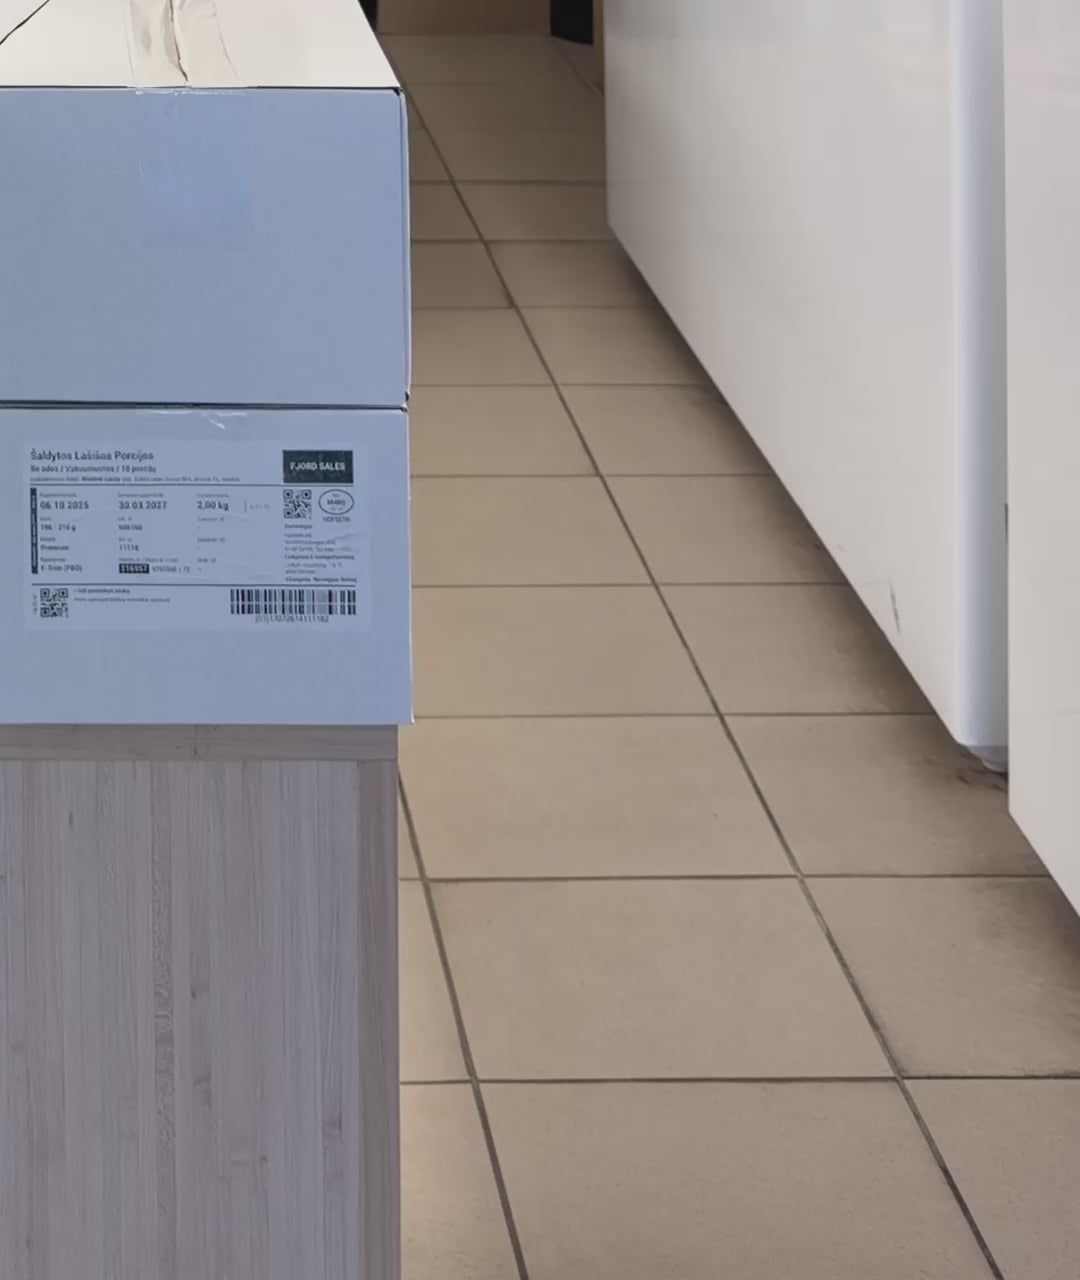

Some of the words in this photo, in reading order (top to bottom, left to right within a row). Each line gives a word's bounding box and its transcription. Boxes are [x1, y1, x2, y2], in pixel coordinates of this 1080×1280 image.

[30, 448, 73, 463] Šaldytos
[75, 450, 112, 461] Lašišos
[114, 450, 154, 463] Porcijos
[290, 461, 317, 471] FJORD
[319, 461, 346, 471] SALES
[197, 500, 217, 511] 2,00
[218, 500, 229, 511] kg
